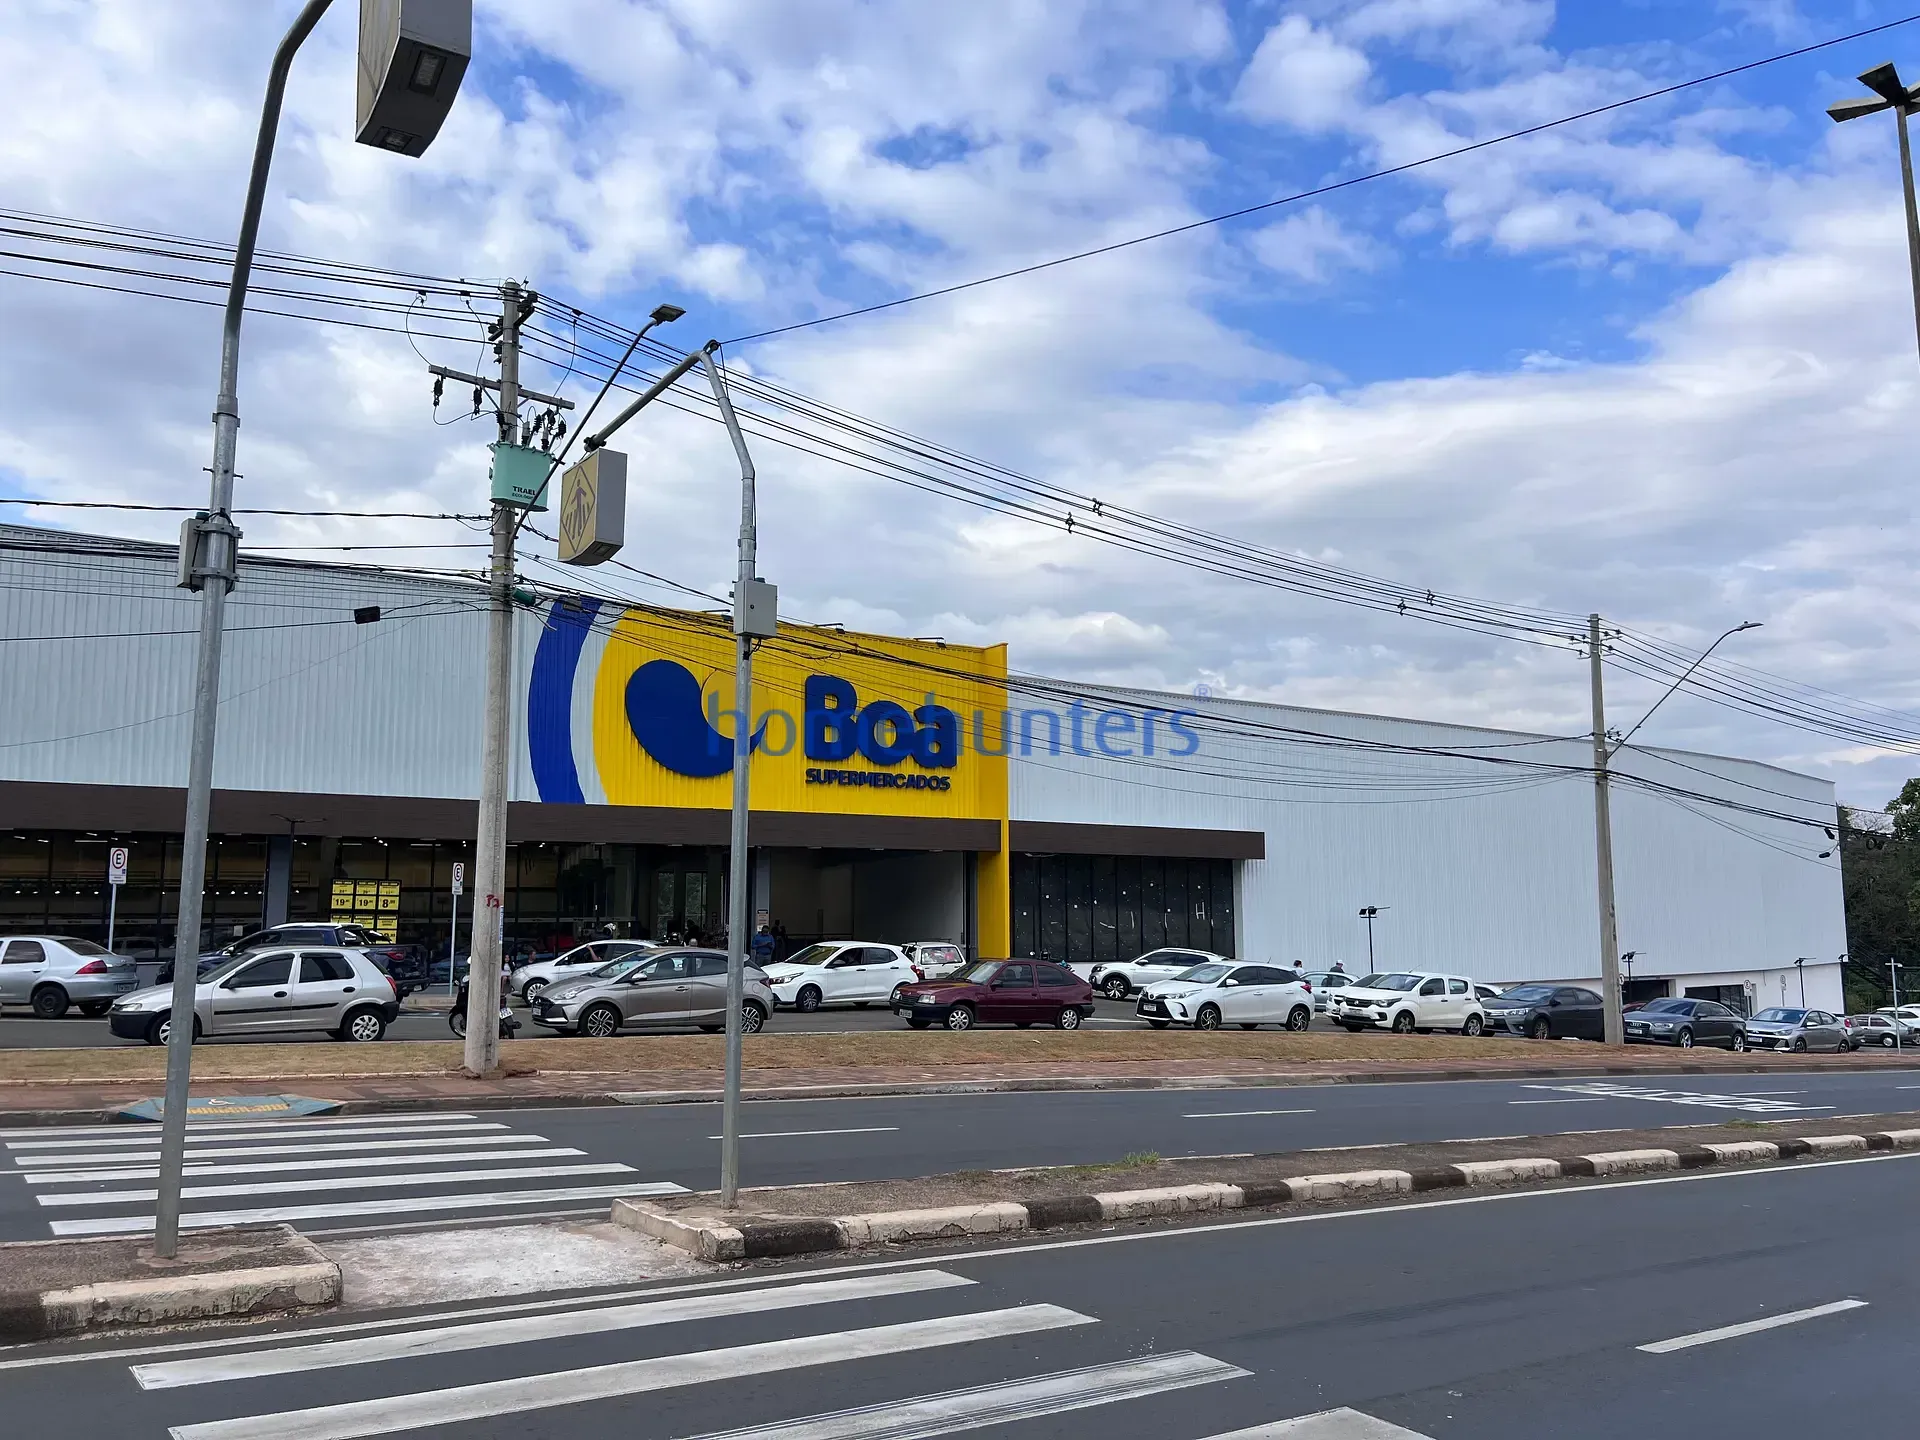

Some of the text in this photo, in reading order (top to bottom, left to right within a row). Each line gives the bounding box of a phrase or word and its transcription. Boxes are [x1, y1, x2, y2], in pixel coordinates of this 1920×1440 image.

[804, 673, 958, 769] Boa
[805, 768, 951, 791] SUPERMERCADOS
[115, 853, 122, 865] E
